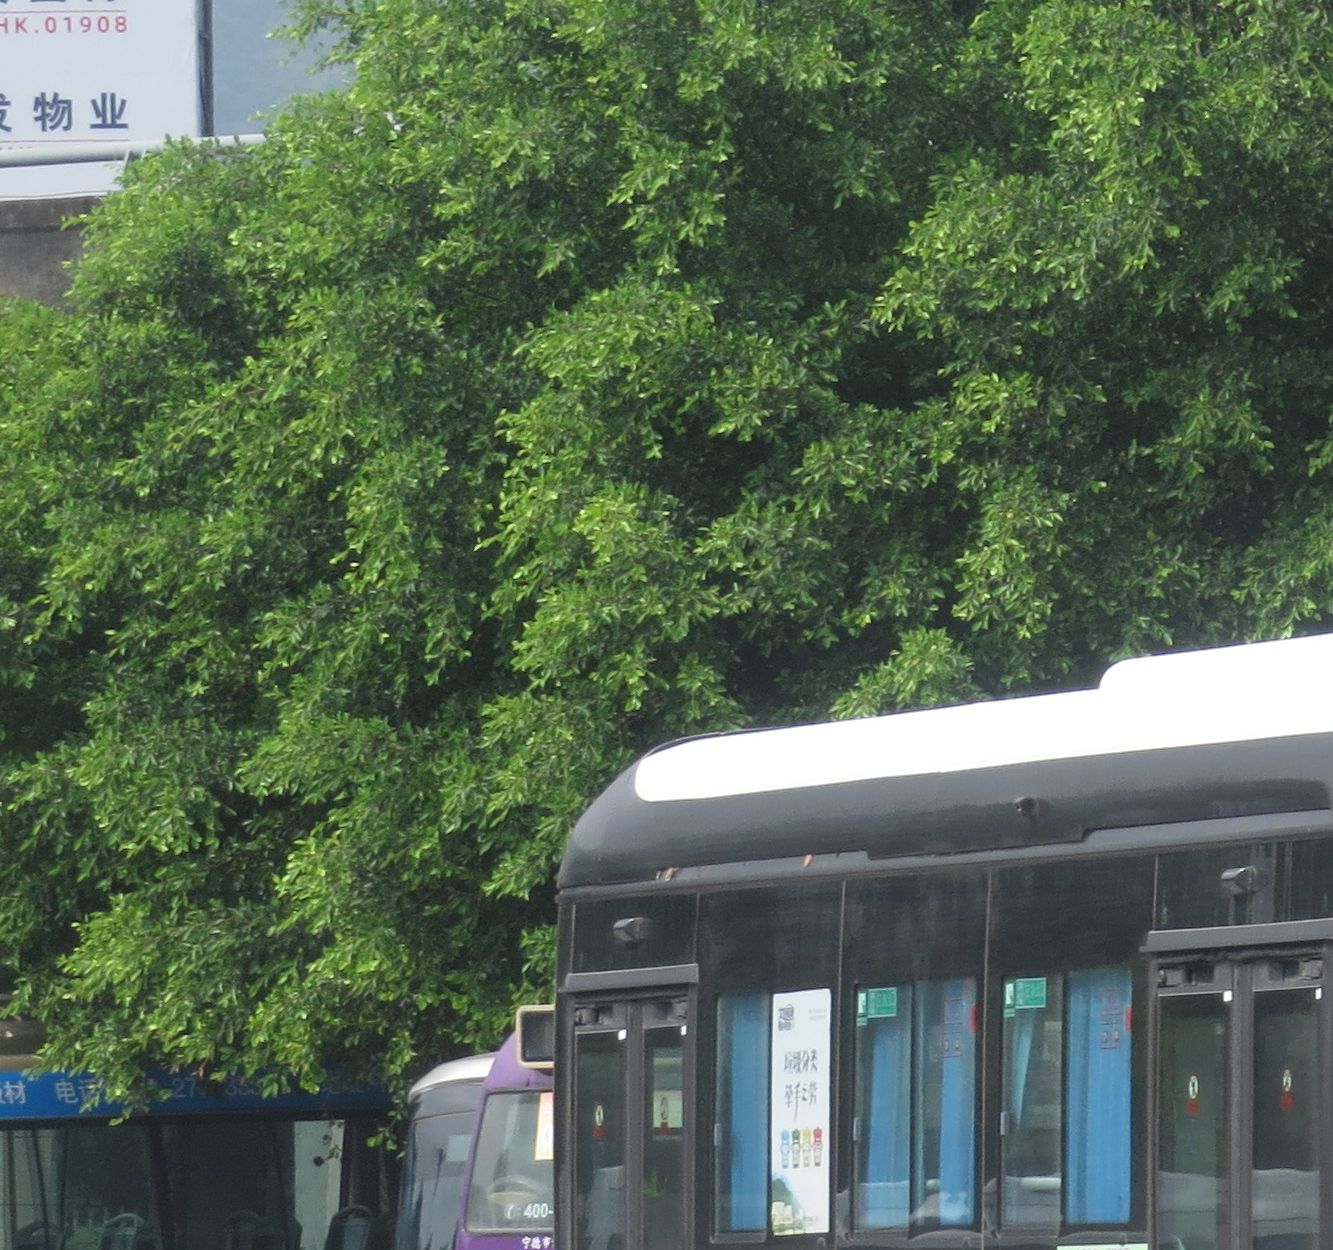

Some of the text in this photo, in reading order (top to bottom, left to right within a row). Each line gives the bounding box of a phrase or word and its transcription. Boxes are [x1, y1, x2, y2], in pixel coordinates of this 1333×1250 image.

[0, 1080, 26, 1104] 材
[521, 1236, 554, 1250] 宁德市
